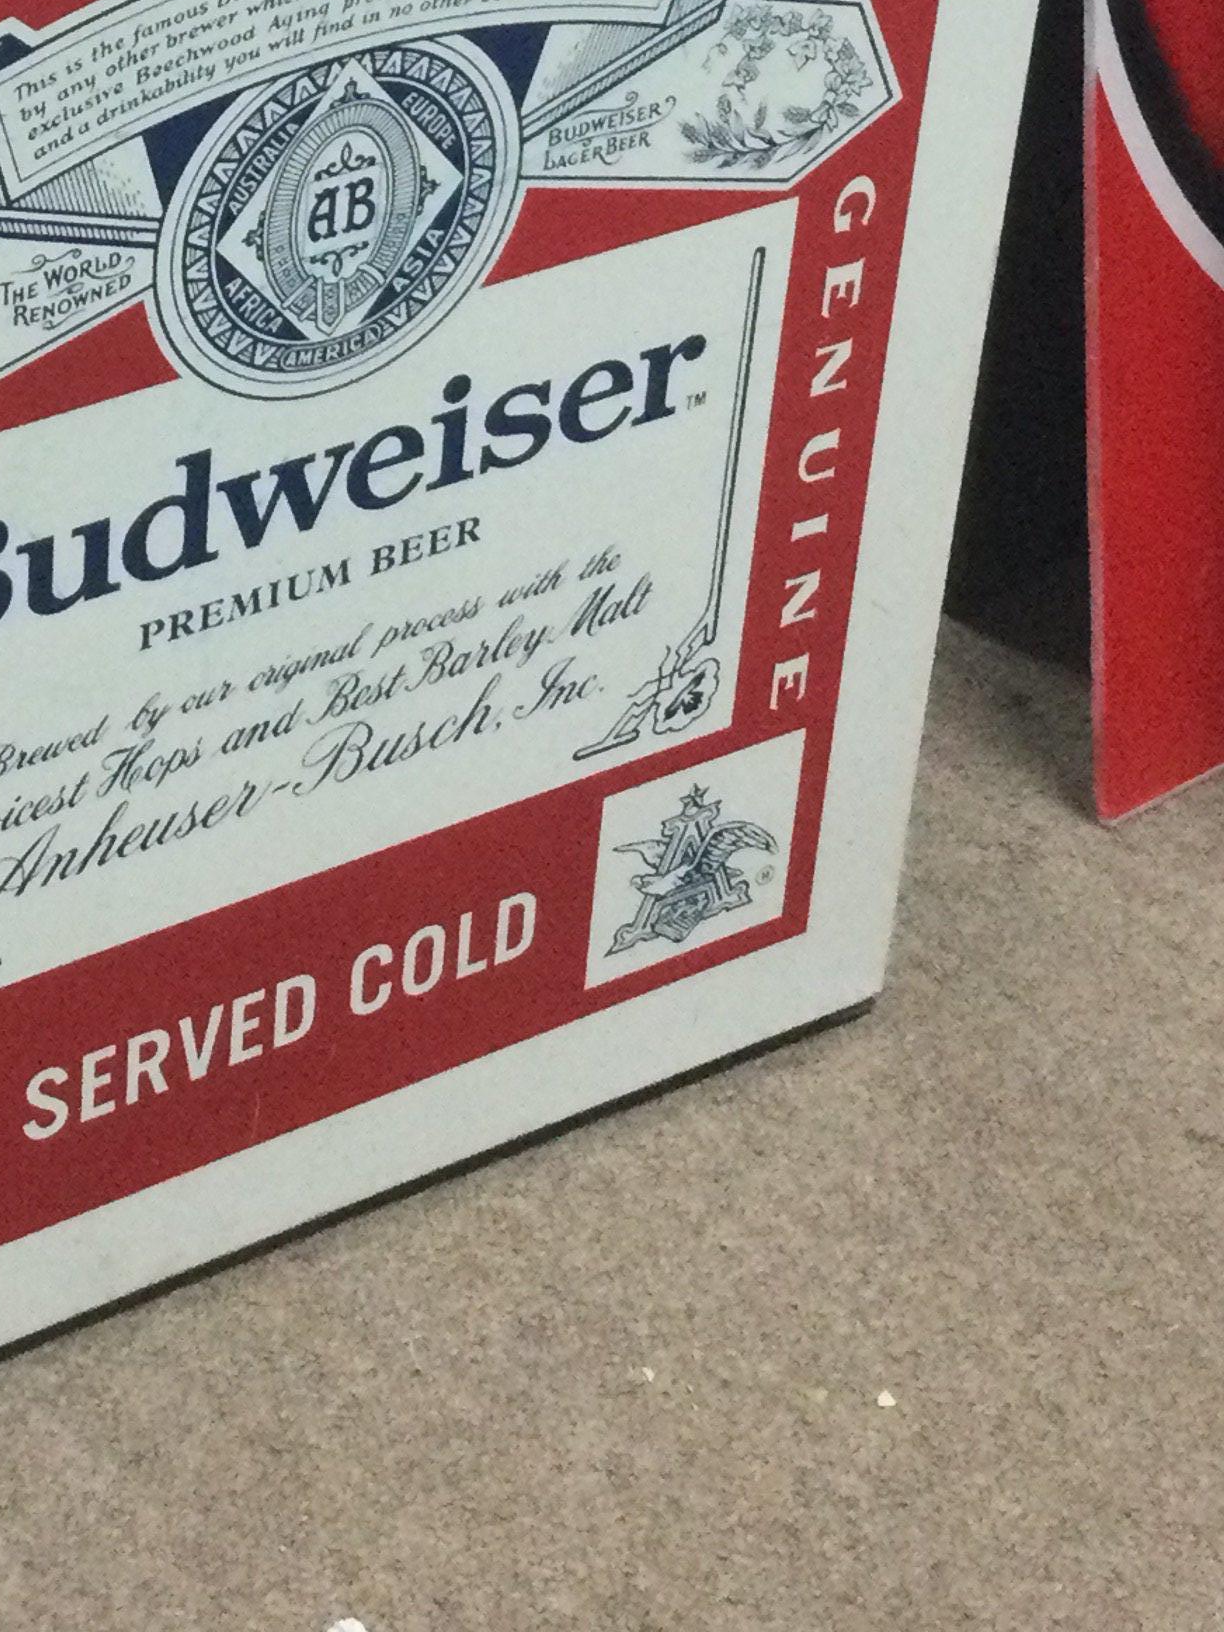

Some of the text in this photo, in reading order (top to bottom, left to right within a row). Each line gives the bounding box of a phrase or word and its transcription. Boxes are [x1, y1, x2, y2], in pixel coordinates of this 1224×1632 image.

[14, 72, 57, 103] This
[65, 58, 83, 75] is
[91, 37, 124, 63] the
[132, 2, 209, 48] famous
[19, 101, 46, 122] by
[57, 75, 96, 101] any
[105, 43, 160, 77] other
[166, 9, 239, 50] brewer
[27, 82, 124, 141] exclusive
[136, 26, 256, 87] Beechwood
[268, 1, 331, 33] Aging
[34, 126, 74, 160] and
[78, 121, 91, 135] a
[96, 63, 216, 126] drinkability
[225, 47, 261, 73] you
[268, 27, 305, 52] will
[312, 13, 355, 44] find
[362, 10, 381, 26] in
[389, 2, 413, 19] no
[401, 91, 459, 151] EUROPE
[548, 102, 663, 147] BUDWEISER
[228, 122, 300, 217] AUSTRALIA
[307, 176, 376, 242] AB
[0, 251, 124, 306] THE WORLD
[13, 274, 132, 327] RENOWNED
[225, 276, 284, 335] AFRICA
[393, 228, 444, 293] ASIA
[284, 325, 380, 367] AMERICA
[769, 175, 876, 711] GENUINE
[138, 516, 481, 651] PREMIUM BEER
[96, 737, 202, 797] Hops
[217, 698, 305, 755] and
[306, 663, 407, 725] Best
[405, 614, 546, 693] Barley
[566, 571, 654, 637] Malt
[127, 692, 171, 737] by
[181, 679, 234, 714] our
[248, 622, 374, 694] original
[371, 594, 483, 659] process
[497, 558, 570, 608] with
[577, 543, 621, 581] the
[512, 655, 605, 720] Inc.
[22, 891, 539, 1141] SERVED COLD
